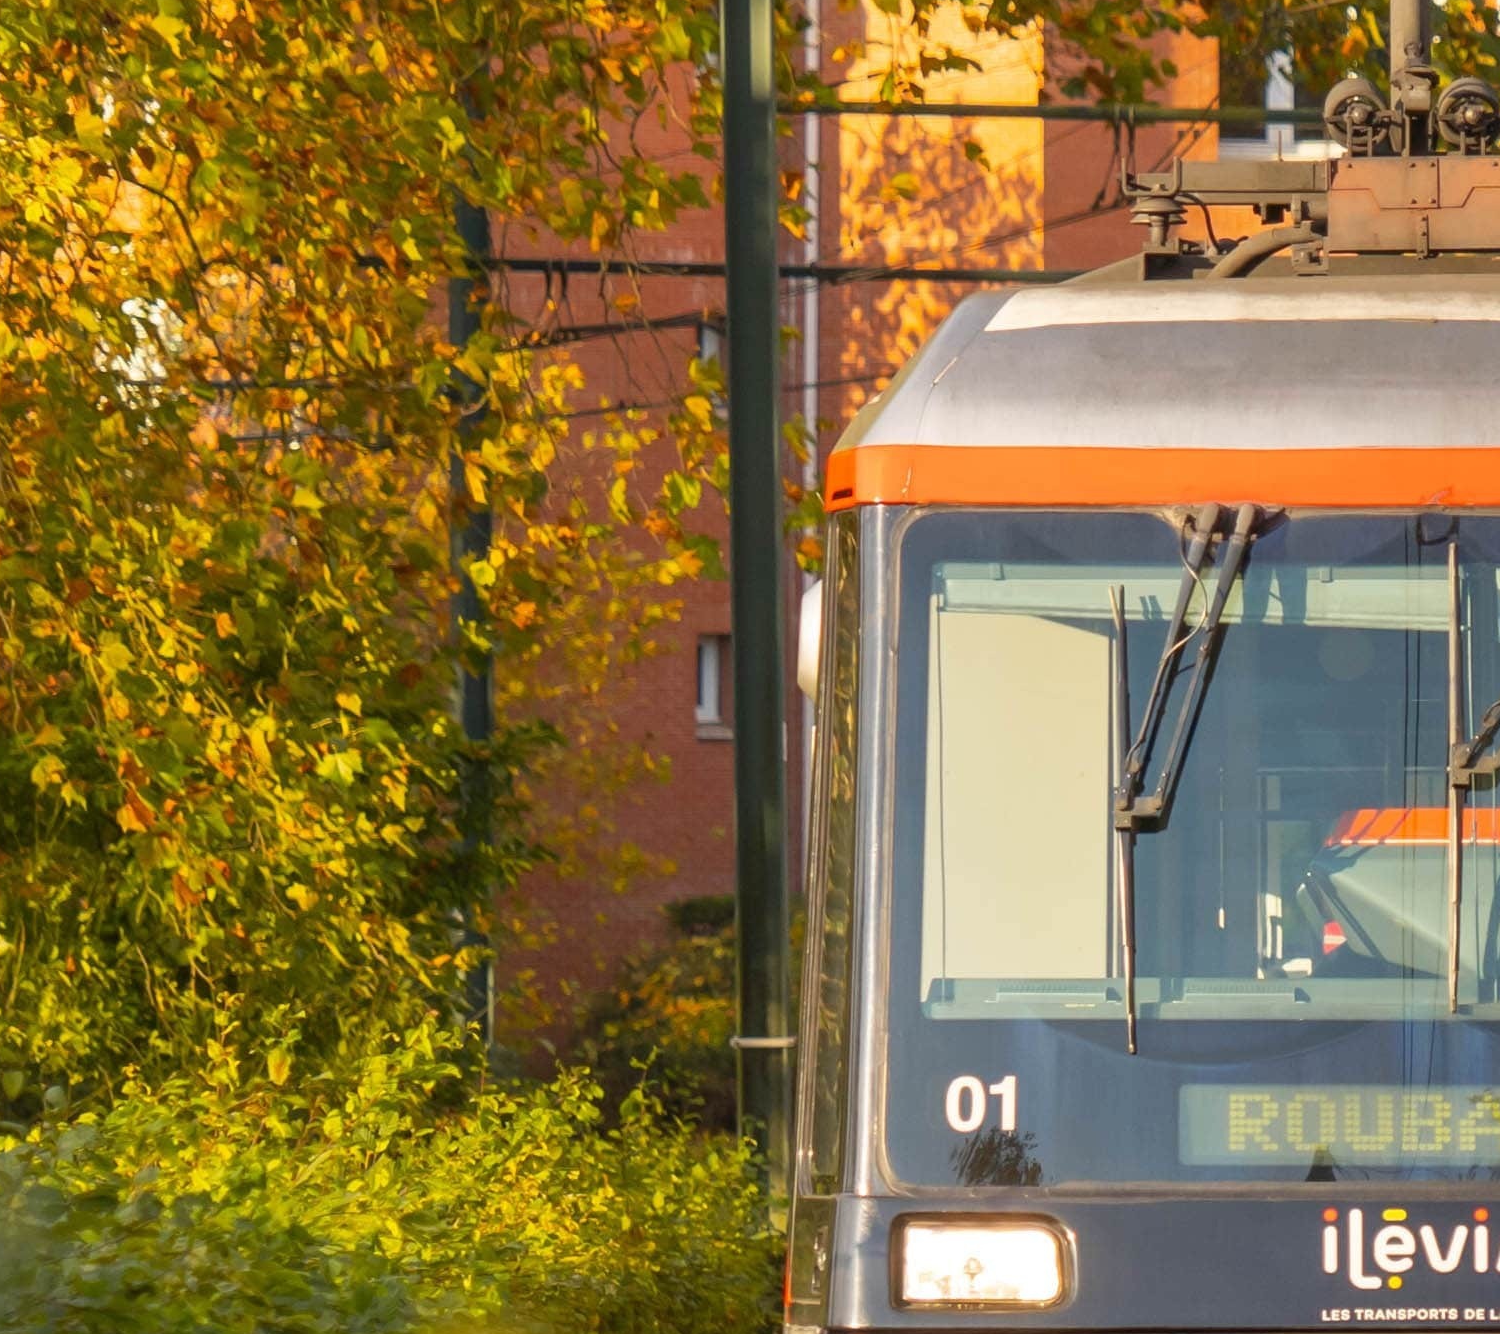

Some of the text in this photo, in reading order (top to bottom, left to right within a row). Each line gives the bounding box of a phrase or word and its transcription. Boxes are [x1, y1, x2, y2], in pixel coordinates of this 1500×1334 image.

[945, 1075, 1016, 1133] 01
[1322, 1309, 1351, 1321] LES
[1354, 1308, 1459, 1321] TRANSPORTS
[1463, 1308, 1486, 1320] DE
